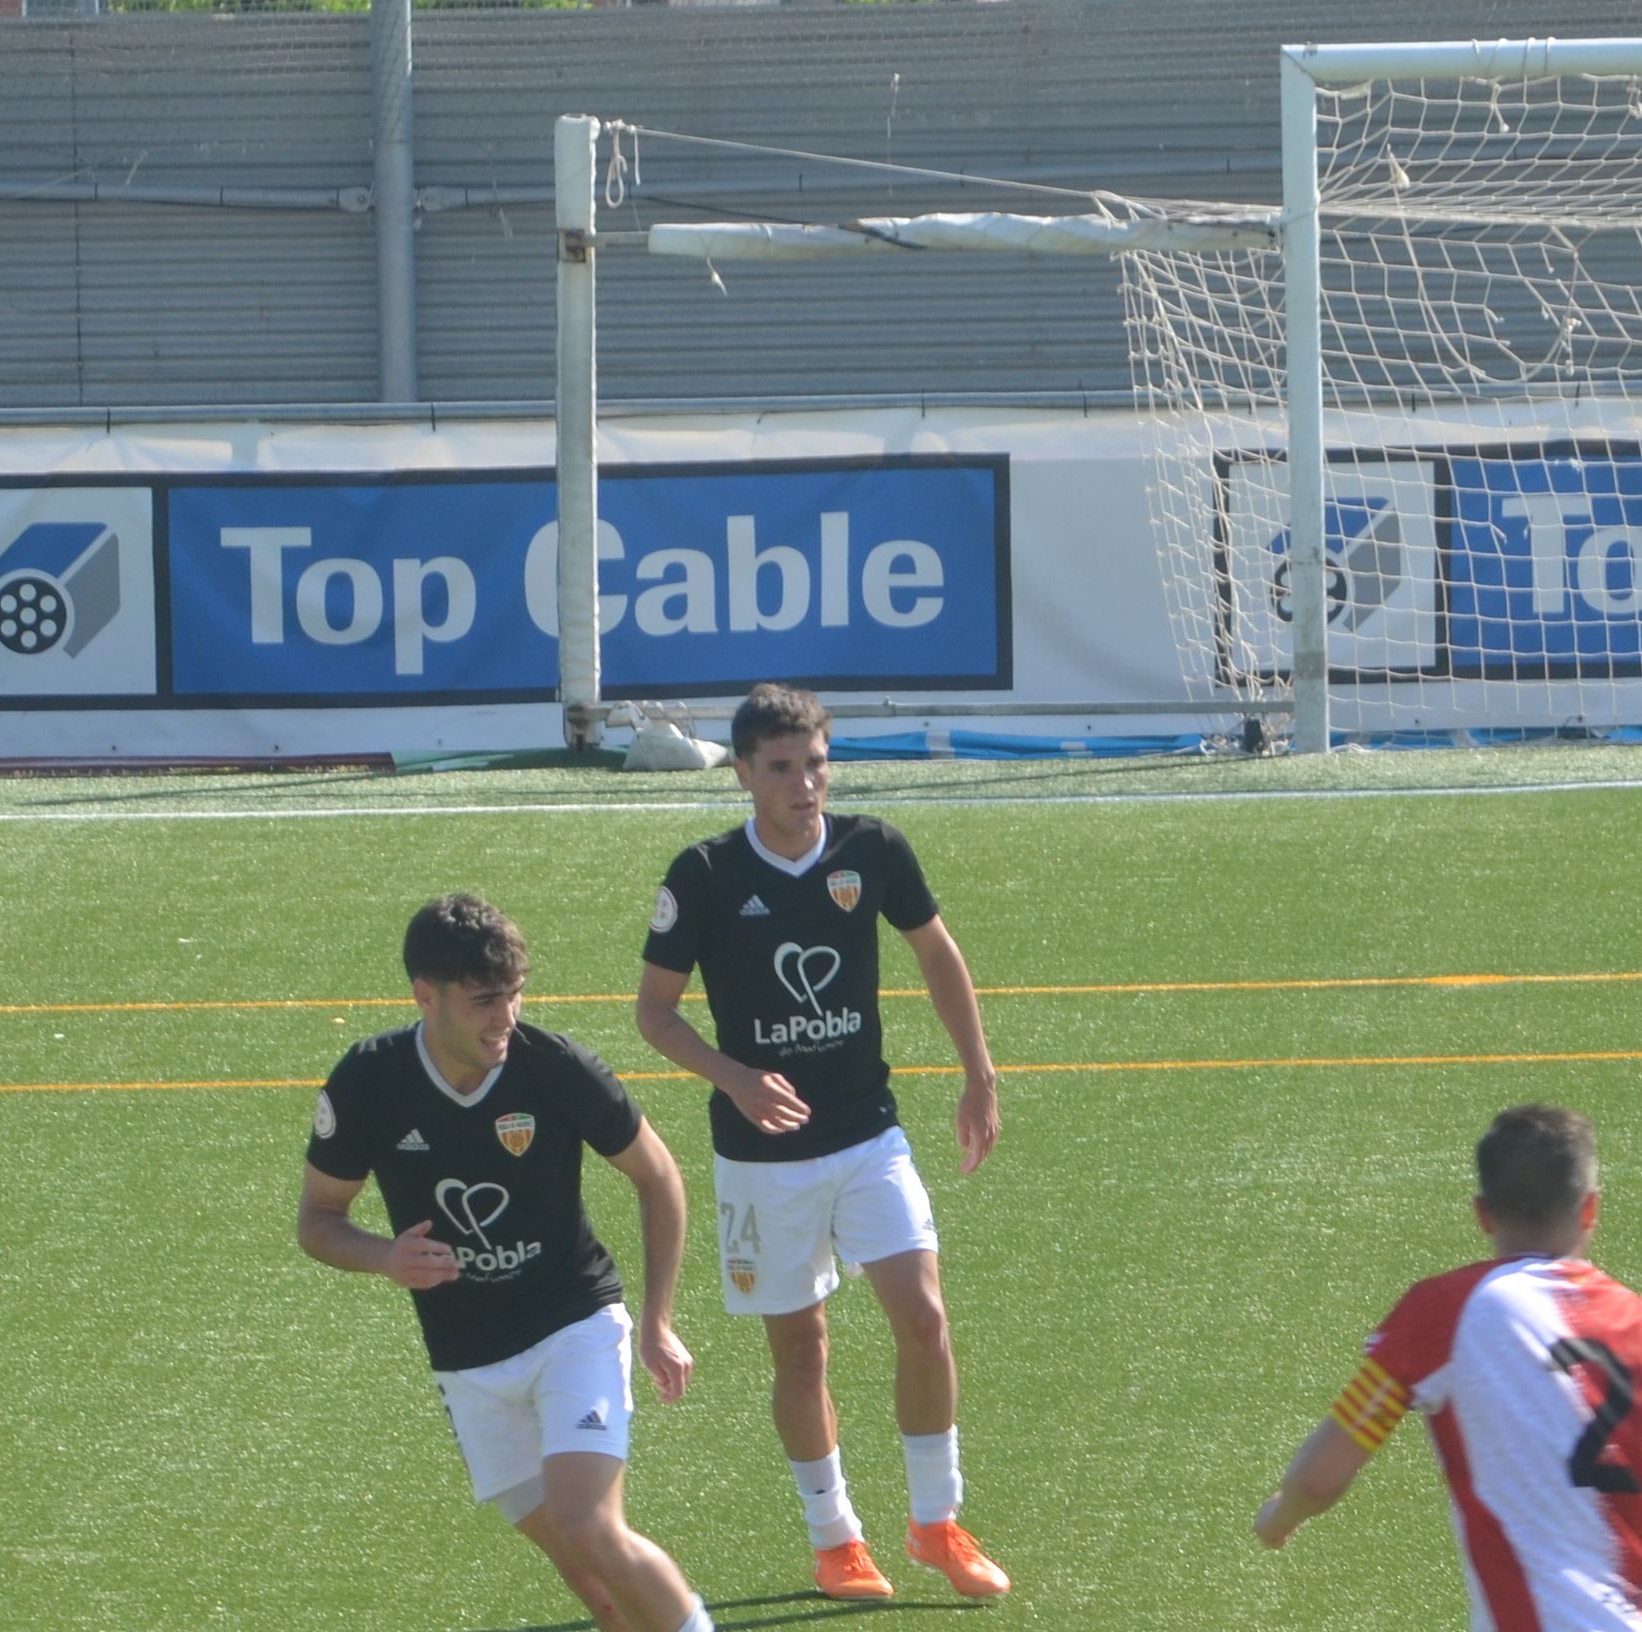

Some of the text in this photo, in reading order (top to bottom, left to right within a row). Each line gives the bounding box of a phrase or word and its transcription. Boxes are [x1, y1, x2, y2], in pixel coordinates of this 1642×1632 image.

[220, 512, 945, 674] Top Cable
[754, 1006, 862, 1044] LaPobla
[720, 1202, 761, 1255] 24
[455, 1240, 541, 1271] Pobla
[1550, 1338, 1641, 1493] 2
